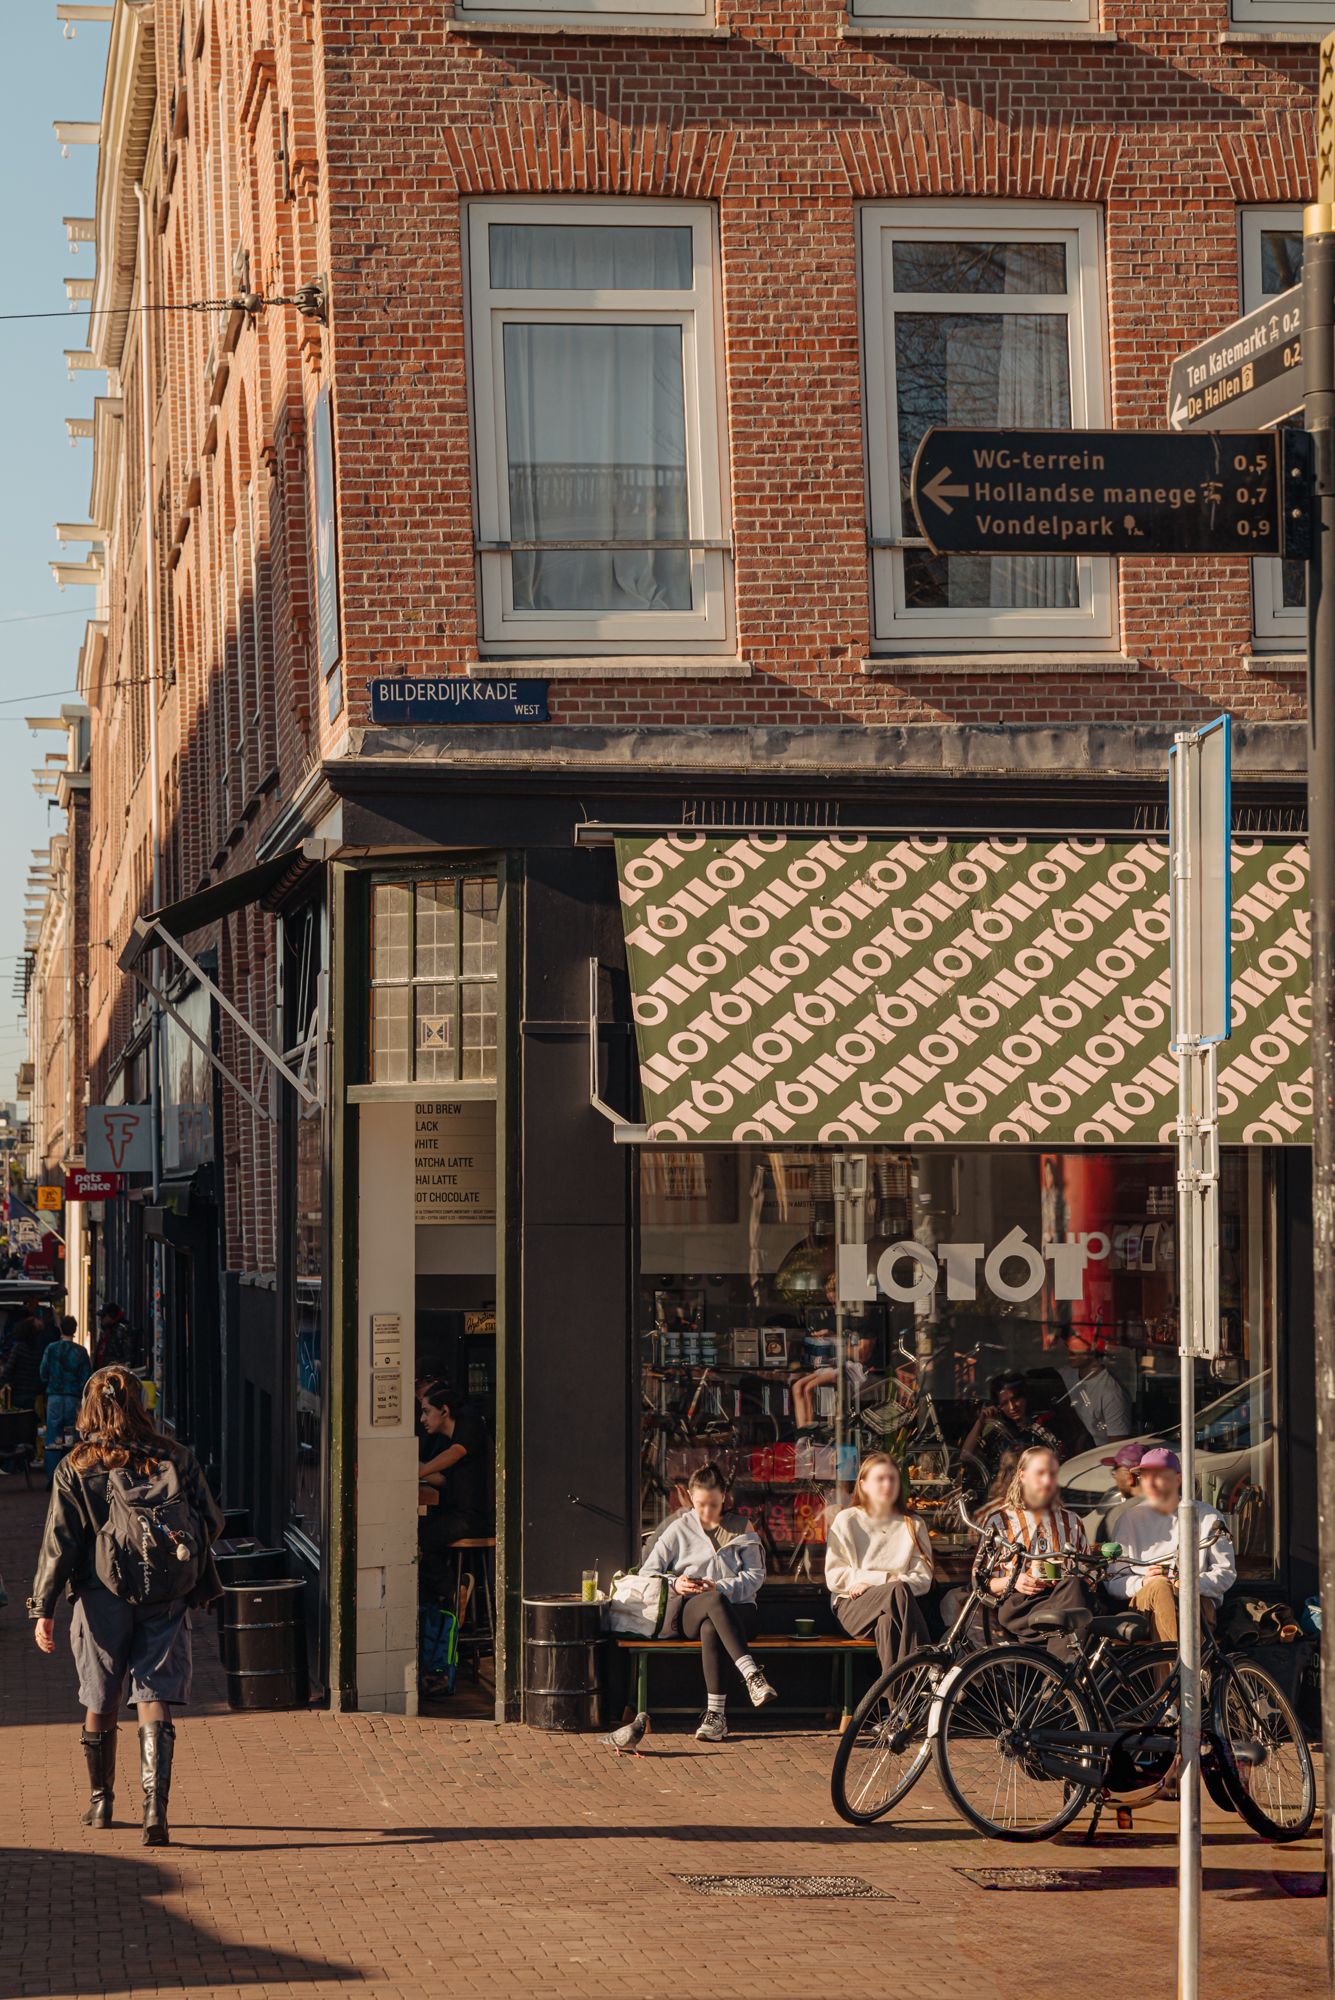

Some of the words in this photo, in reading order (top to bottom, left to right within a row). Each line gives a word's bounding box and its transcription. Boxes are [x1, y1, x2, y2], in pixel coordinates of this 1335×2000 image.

[1187, 364, 1207, 388] Ten
[1209, 325, 1268, 376] Katemarkt
[1283, 308, 1300, 332] 0,2
[1188, 397, 1202, 419] De
[1204, 376, 1240, 410] Hallen
[1284, 343, 1301, 368] 0,2
[973, 449, 1105, 470] WG-terrein
[1234, 455, 1268, 474] 0,5
[975, 482, 1095, 503] Hollandse
[1104, 487, 1197, 509] manege
[1236, 488, 1268, 507] 0,7
[976, 514, 1114, 538] Vondelpark
[1236, 520, 1271, 539] 0,9
[379, 682, 518, 706] BILDERDIJKKADE
[514, 704, 540, 715] WEST
[416, 1104, 434, 1115] OLD
[436, 1104, 462, 1115] BREW
[415, 1121, 439, 1132] LACK
[447, 1157, 475, 1168] LATTE
[75, 1173, 103, 1185] pets
[415, 1175, 430, 1185] HAI
[432, 1175, 458, 1185] LATTE
[79, 1182, 112, 1194] place
[415, 1192, 428, 1203] OT
[429, 1192, 480, 1203] CHOCOLATE
[838, 1225, 1084, 1303] LOT61
